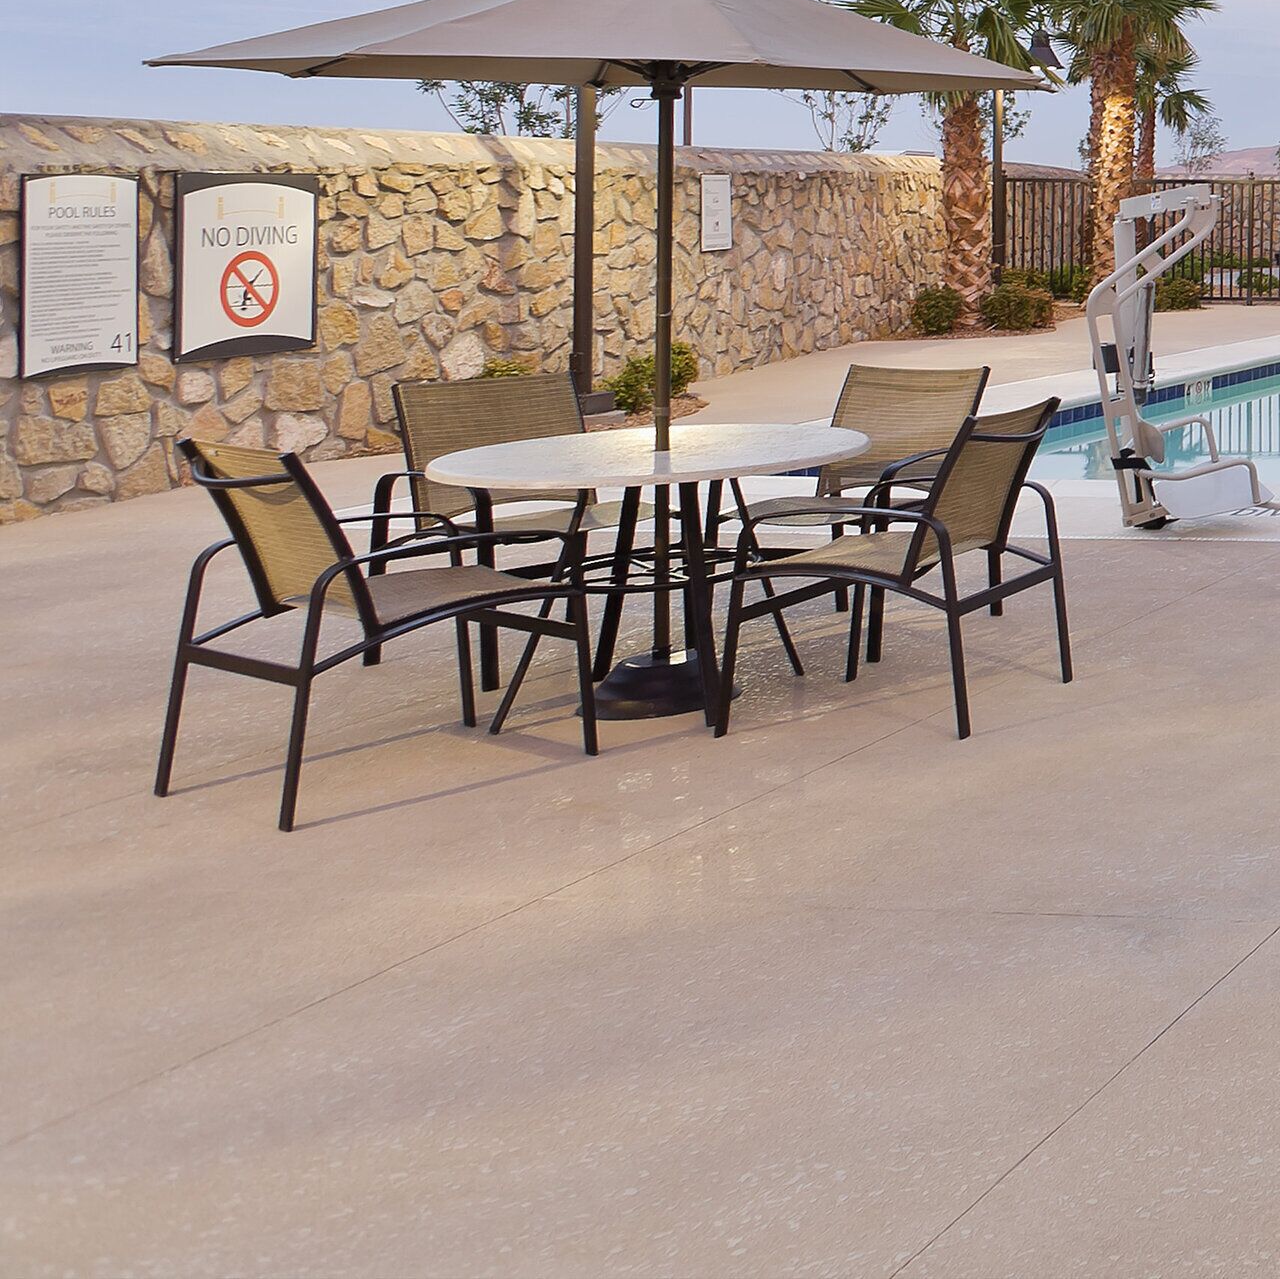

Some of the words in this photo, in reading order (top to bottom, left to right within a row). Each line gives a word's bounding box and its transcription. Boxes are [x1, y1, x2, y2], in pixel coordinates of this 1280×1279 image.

[48, 206, 80, 219] POOL
[82, 206, 116, 218] RULES
[201, 227, 231, 247] NO
[236, 225, 298, 246] DIVING
[50, 341, 94, 355] WARNING
[110, 332, 132, 353] 41
